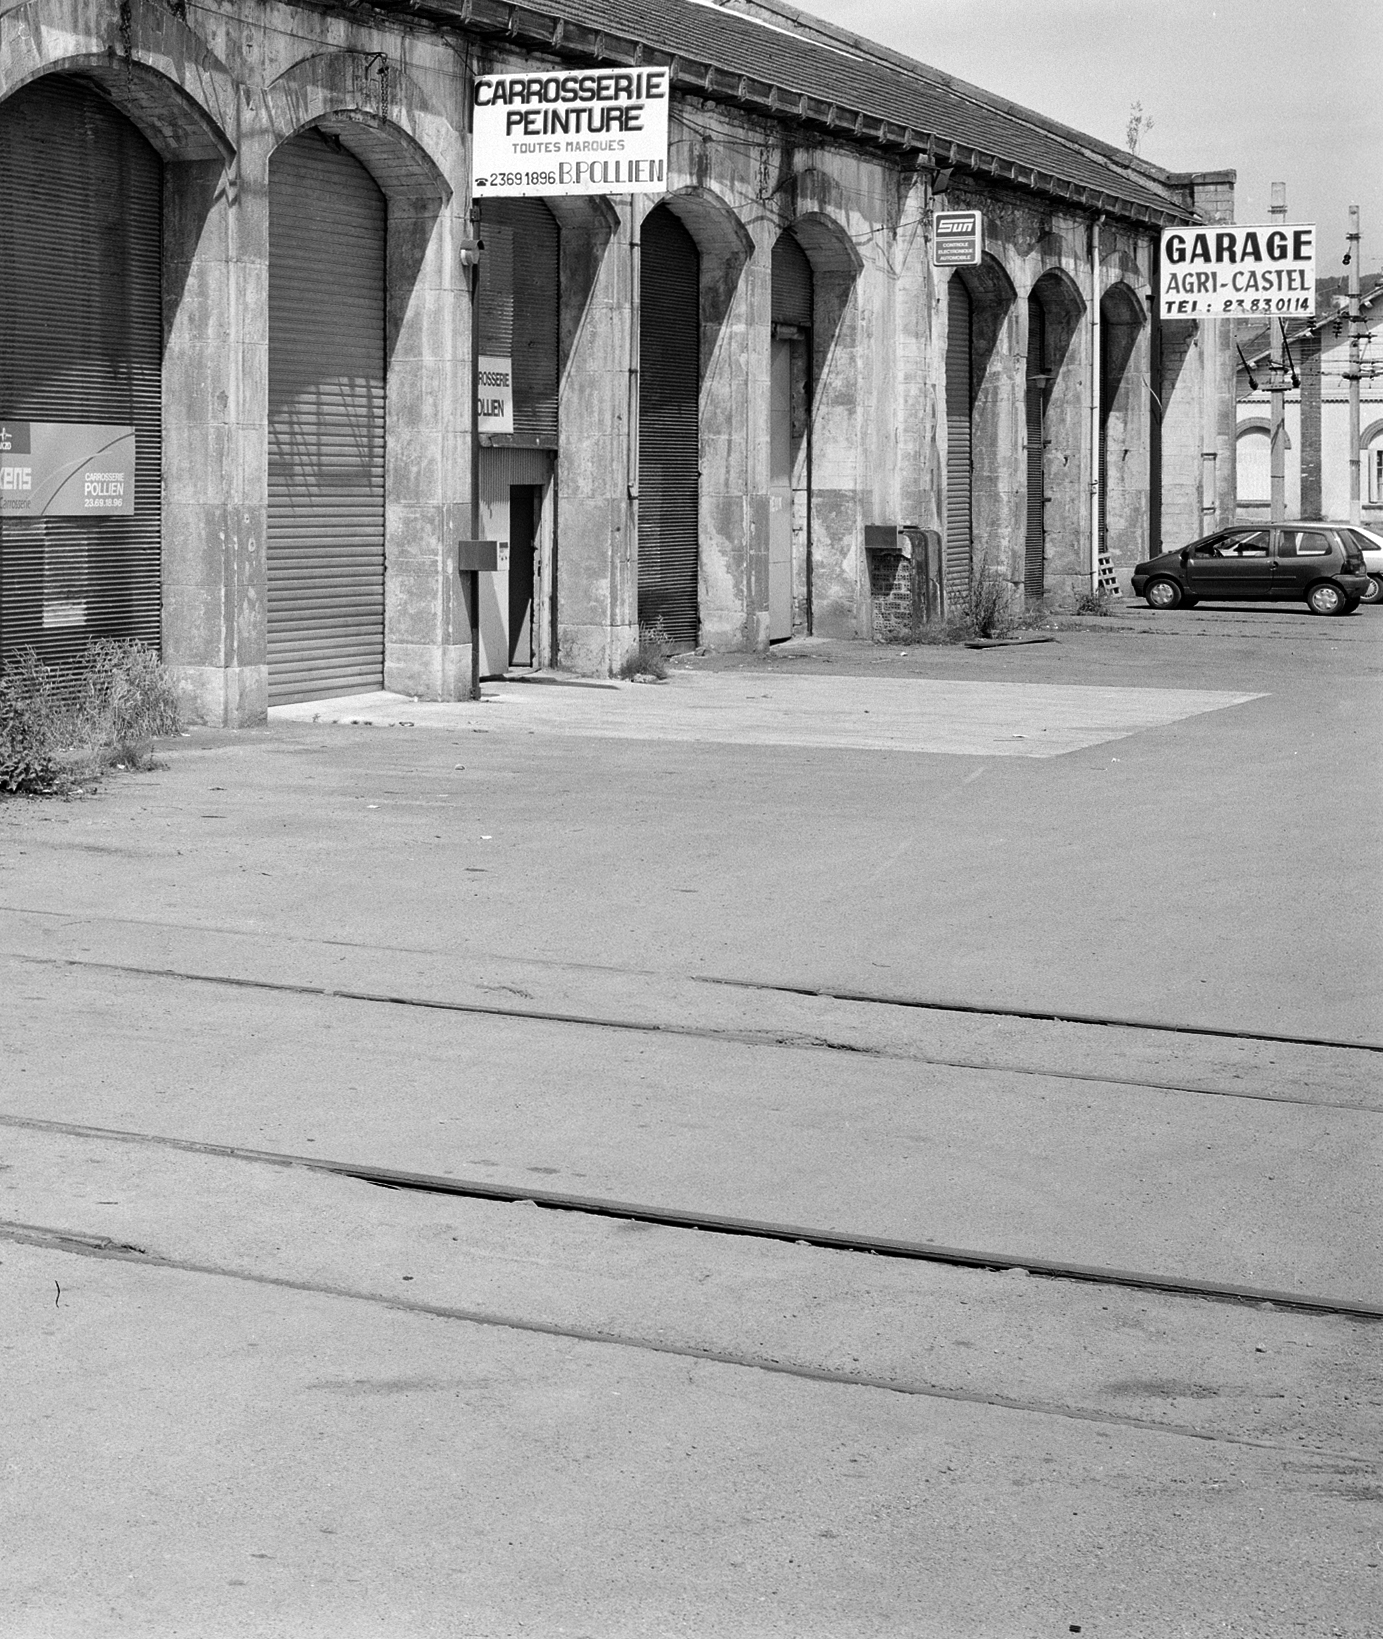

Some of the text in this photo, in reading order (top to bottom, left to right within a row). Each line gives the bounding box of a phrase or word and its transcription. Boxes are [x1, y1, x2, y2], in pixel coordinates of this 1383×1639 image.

[474, 73, 666, 106] CARROSSERIE
[506, 104, 645, 136] PEINTURE
[512, 139, 625, 154] TOUTES MARQUES
[559, 159, 664, 185] B.POLLIEN
[1165, 230, 1312, 265] GARAGE
[1165, 269, 1312, 294] AGRI-CASTEL
[84, 472, 124, 481] CARROSSERIE
[84, 482, 124, 496] POLLIEN
[84, 498, 123, 507] 23.69.18.96
